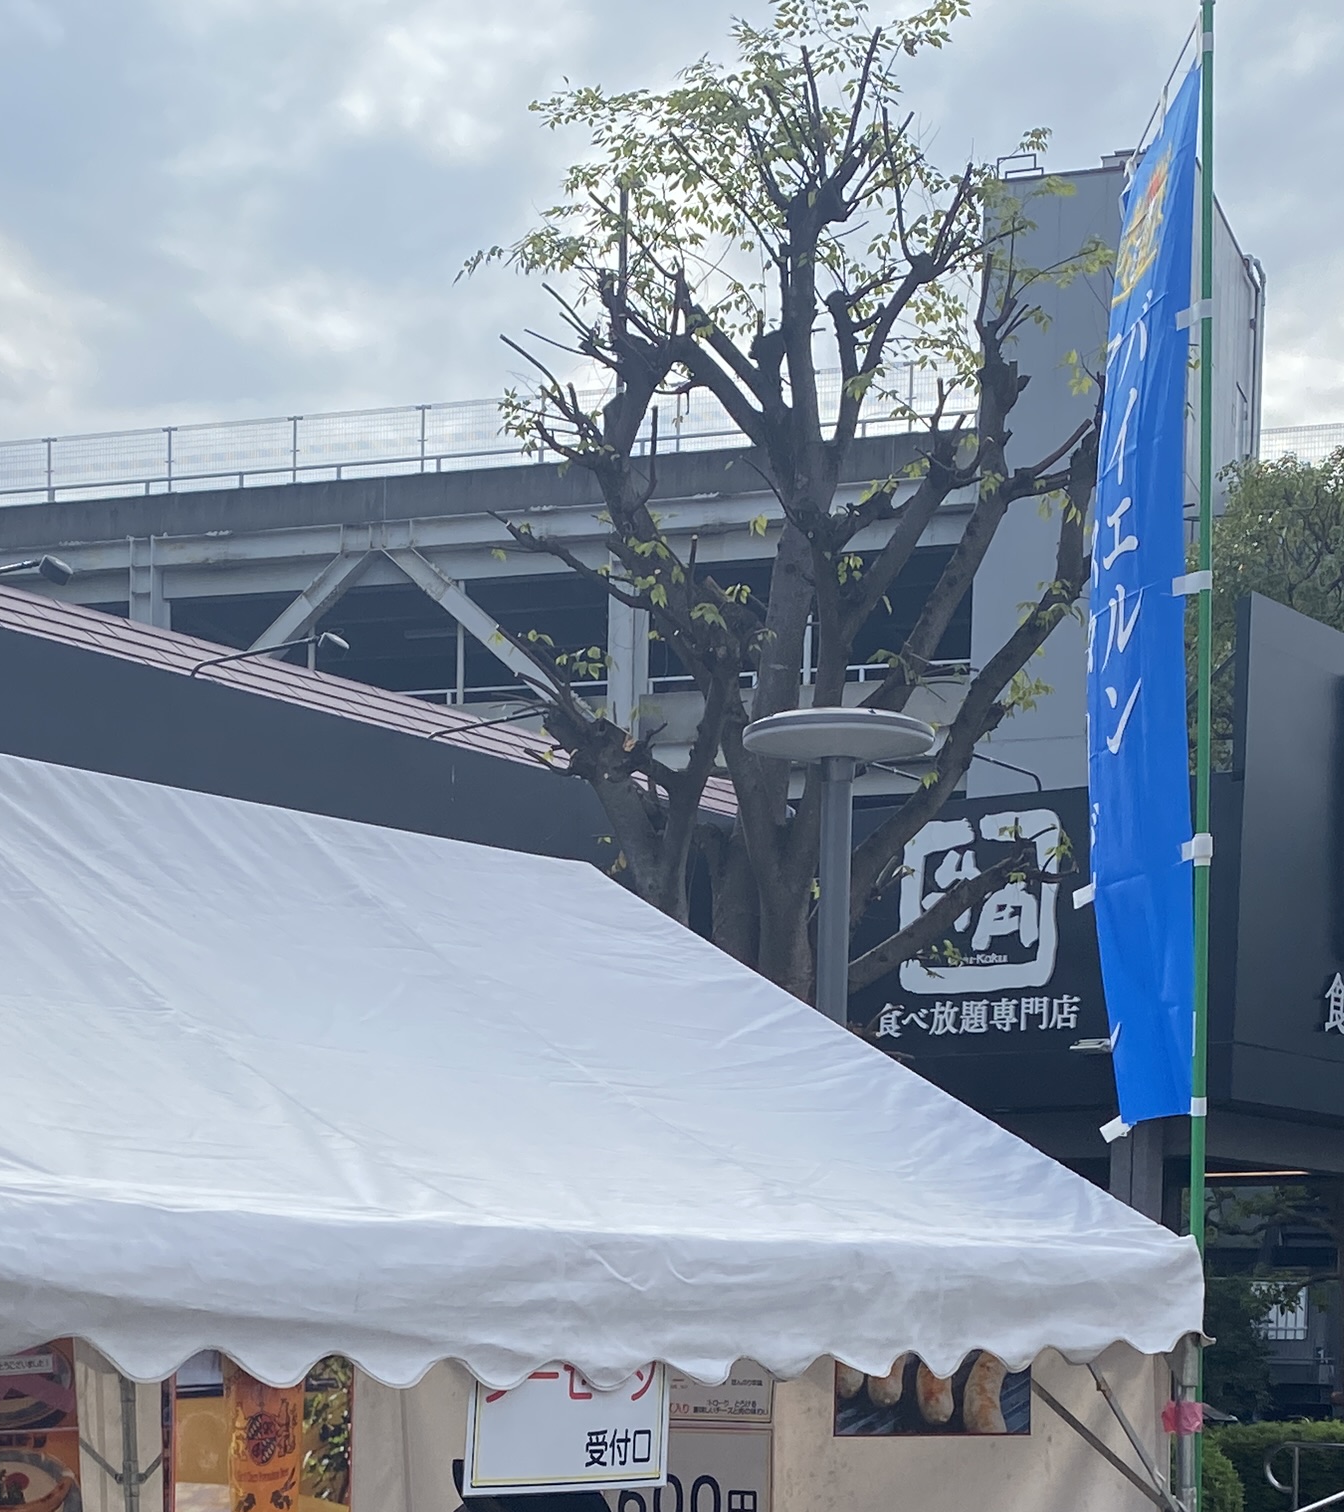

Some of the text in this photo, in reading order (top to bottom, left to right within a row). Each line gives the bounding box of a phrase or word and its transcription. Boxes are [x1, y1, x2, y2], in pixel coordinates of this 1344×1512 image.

[876, 995, 1081, 1038] 食べ放題専門店
[585, 1429, 651, 1467] 受付口
